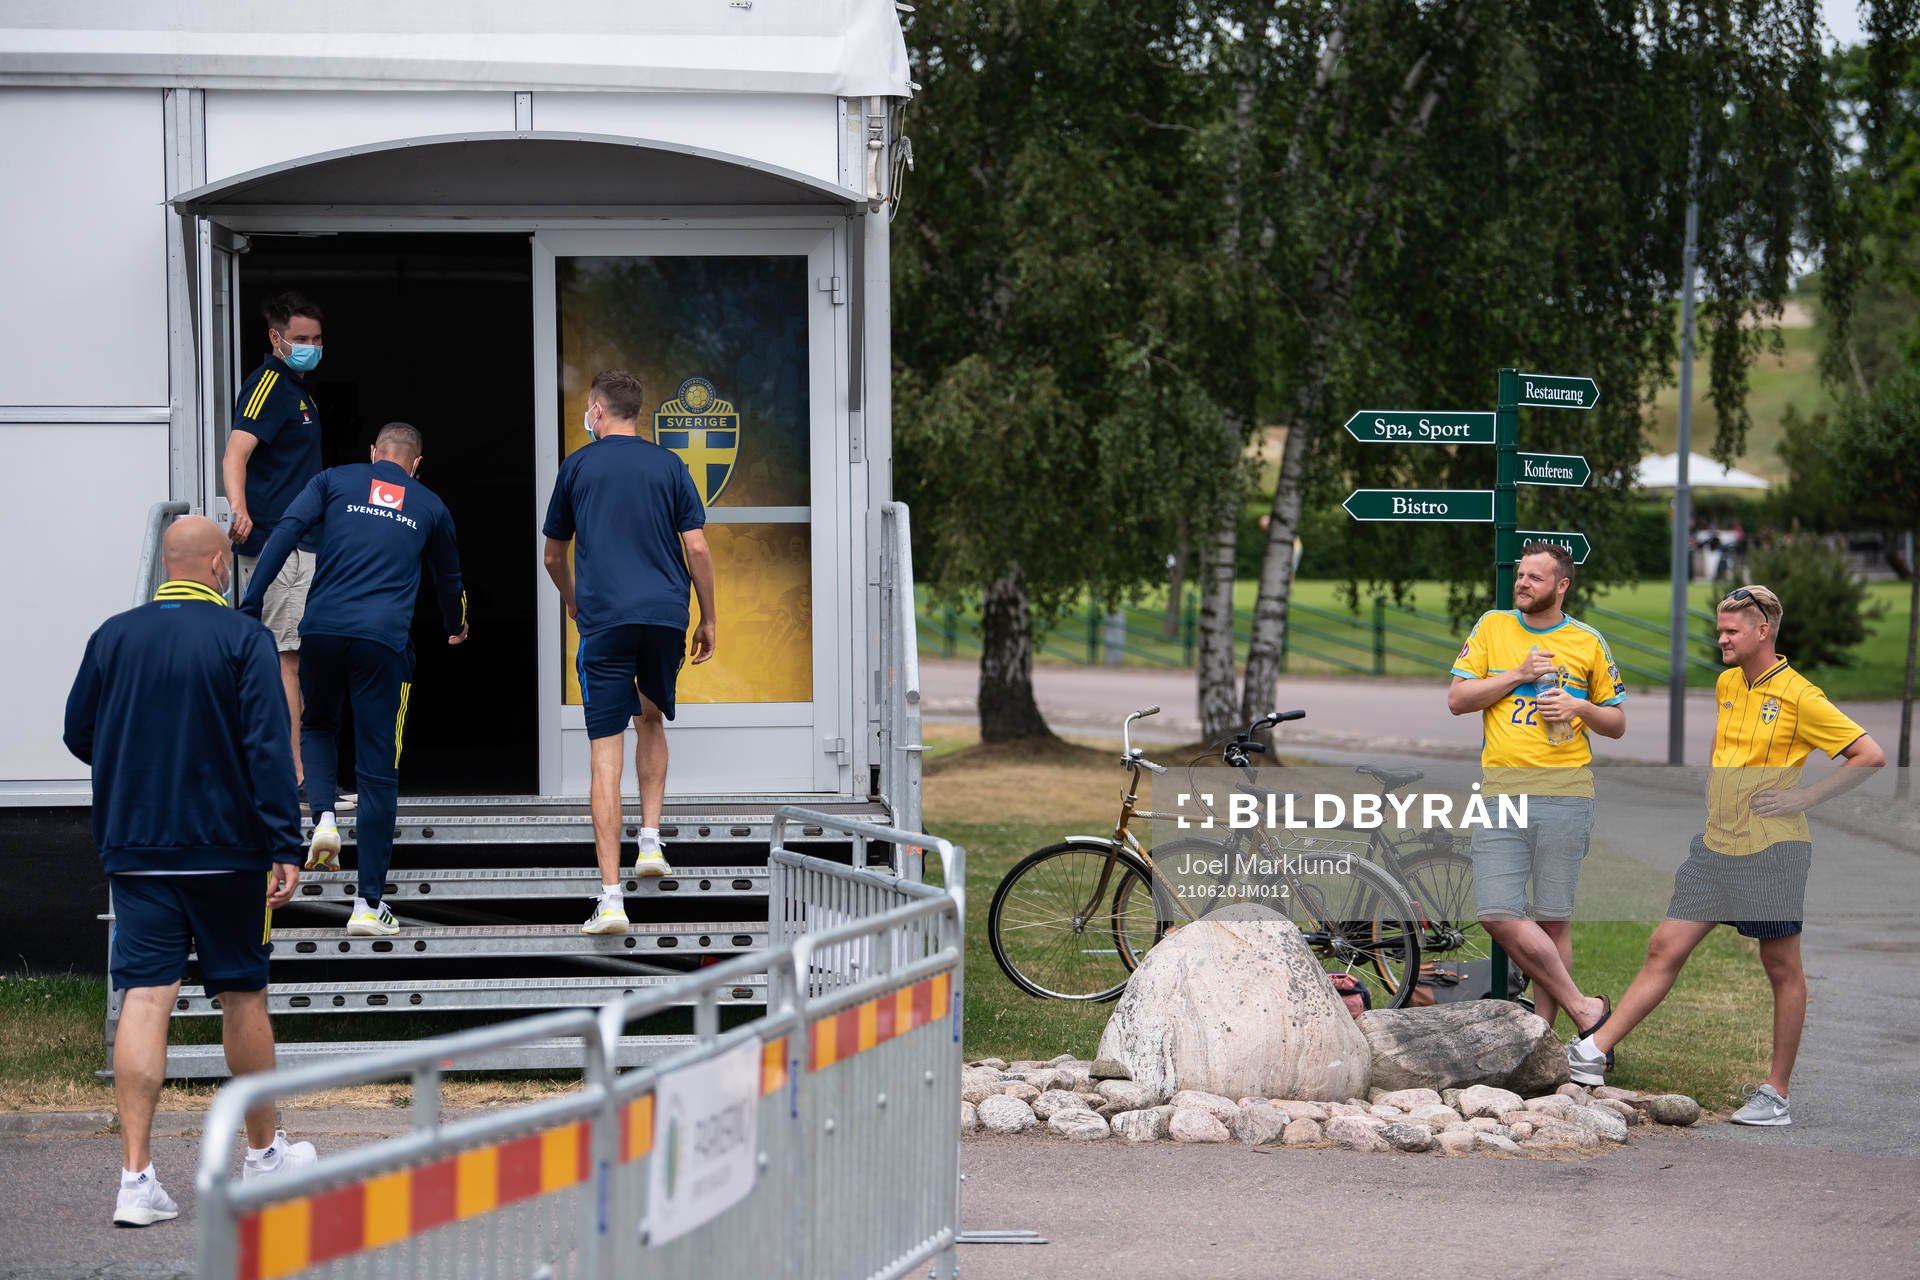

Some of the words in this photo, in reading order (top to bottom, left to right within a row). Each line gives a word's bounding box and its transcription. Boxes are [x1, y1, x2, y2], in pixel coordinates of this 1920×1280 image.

[1525, 381, 1584, 405] Restaurang
[666, 417, 728, 427] SVERIGE
[1374, 418, 1413, 439] Spa,
[1418, 418, 1470, 440] Sport
[1524, 460, 1574, 480] Konferens
[1392, 496, 1449, 515] Bistro
[346, 504, 394, 519] SVENSKA
[395, 513, 418, 530] SPEL
[1511, 698, 1539, 726] 22
